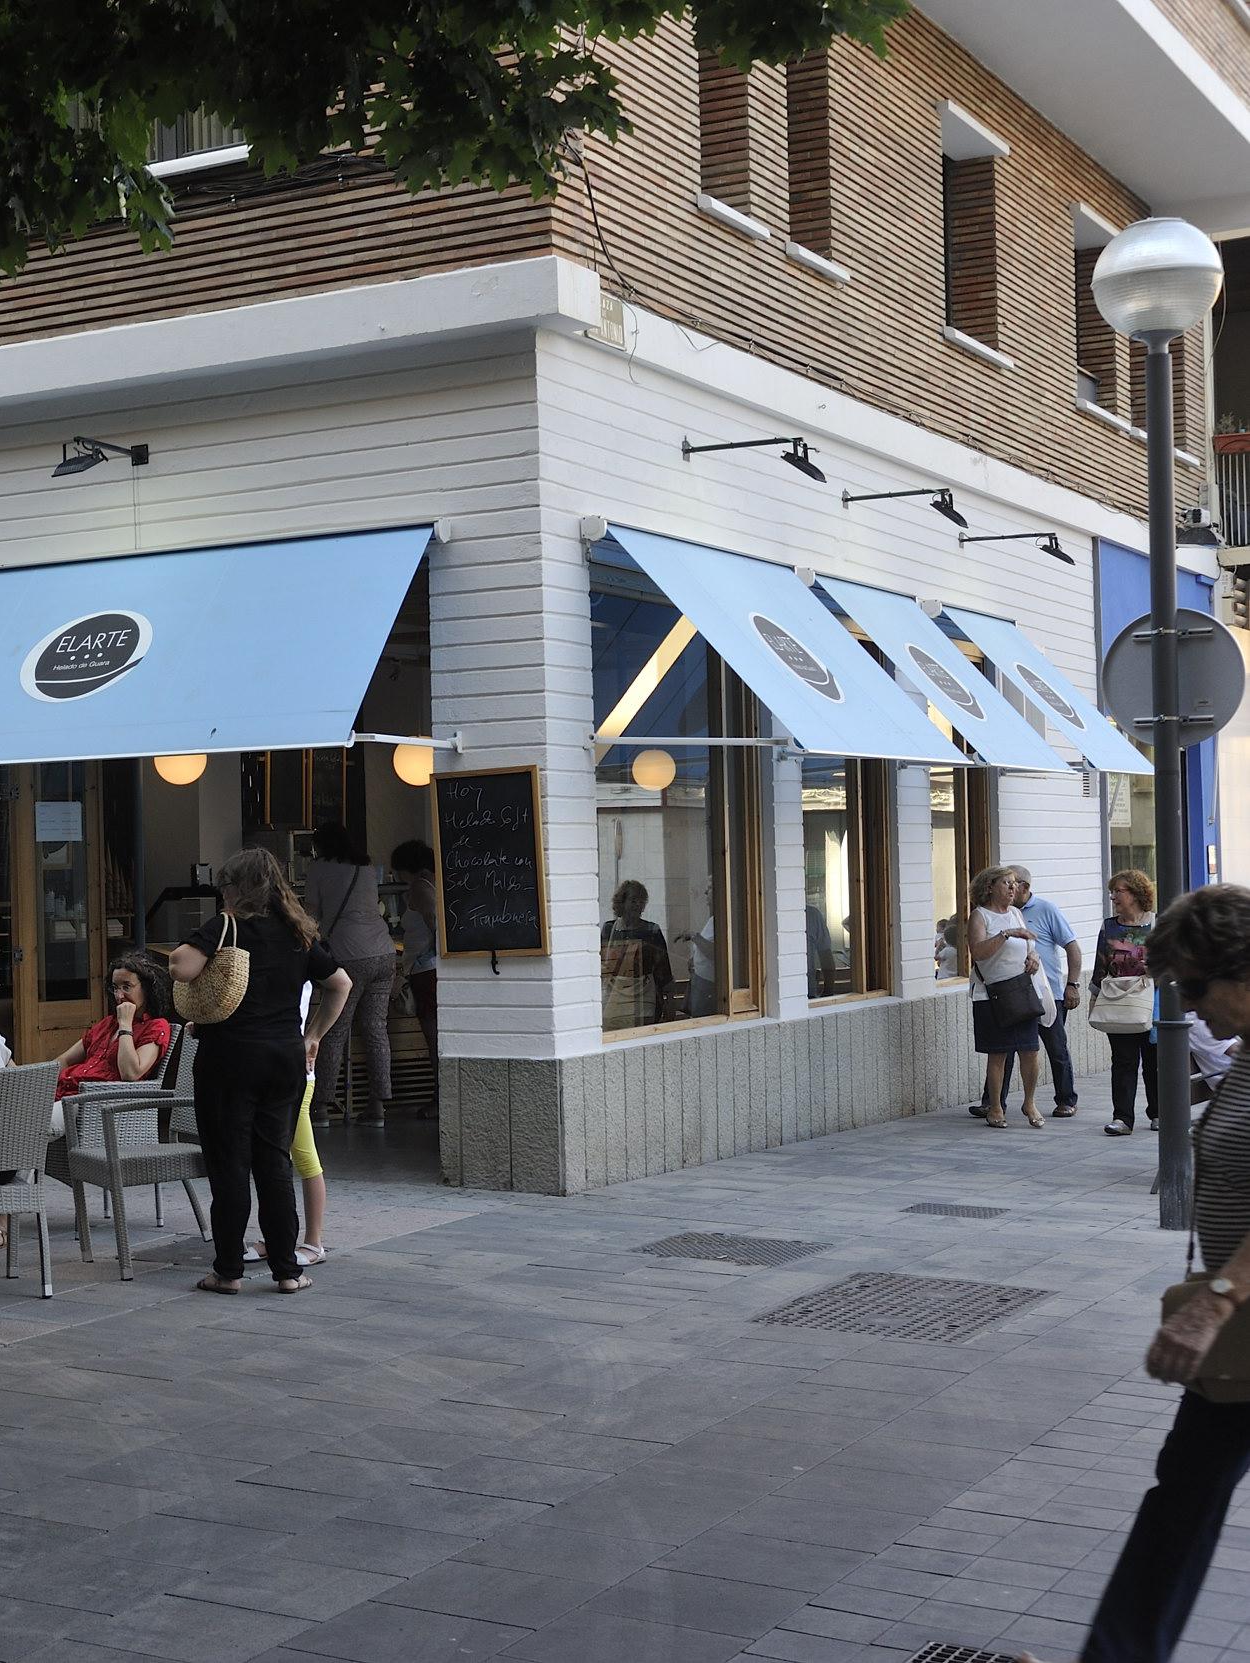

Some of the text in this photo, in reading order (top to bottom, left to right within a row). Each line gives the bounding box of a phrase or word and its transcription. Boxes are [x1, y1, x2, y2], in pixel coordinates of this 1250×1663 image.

[56, 629, 132, 653] ELARTE
[52, 663, 78, 671] Helado
[445, 848, 511, 870] Chocolate
